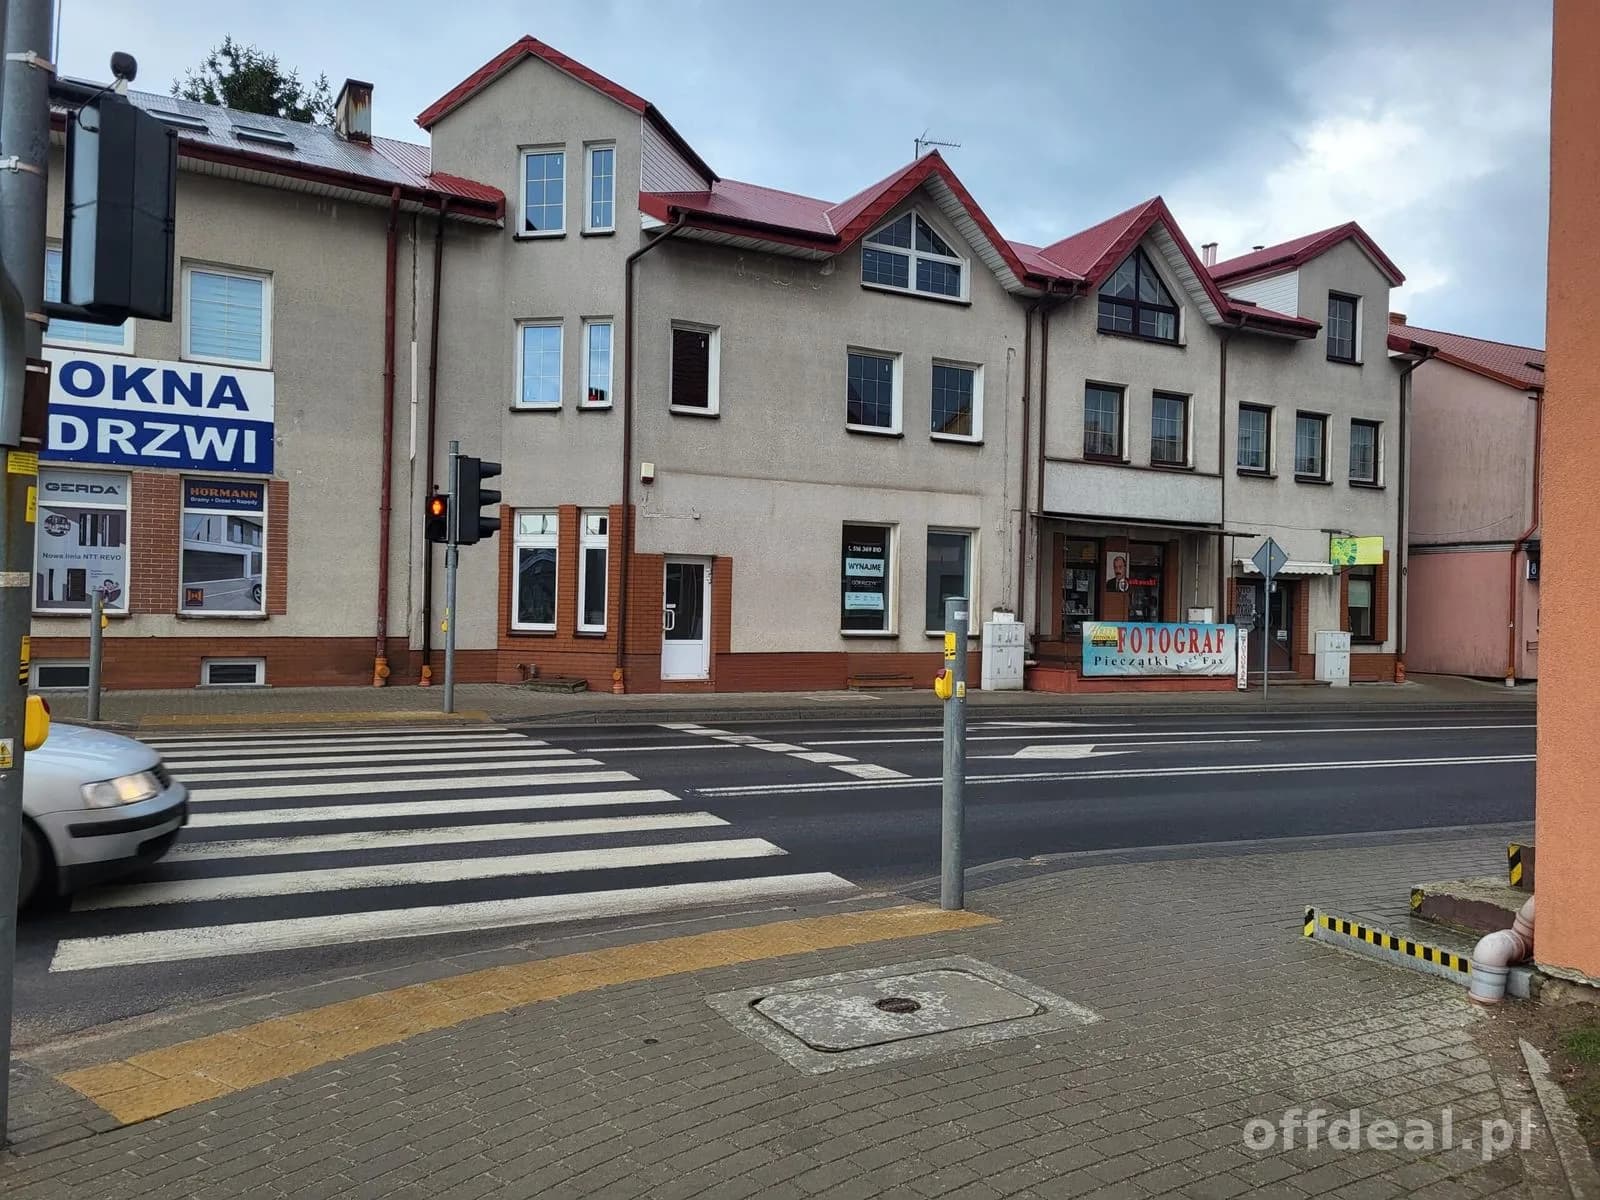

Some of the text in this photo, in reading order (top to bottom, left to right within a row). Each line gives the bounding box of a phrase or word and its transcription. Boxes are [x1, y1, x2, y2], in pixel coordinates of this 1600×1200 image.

[59, 360, 249, 411] OKNA
[48, 414, 256, 464] DRZWI
[45, 482, 119, 495] GERDA
[848, 562, 881, 573] WYNAJMĘ
[1117, 627, 1225, 654] FOTOGRAF
[1094, 655, 1168, 668] Pieczątki
[1202, 656, 1224, 665] Fax
